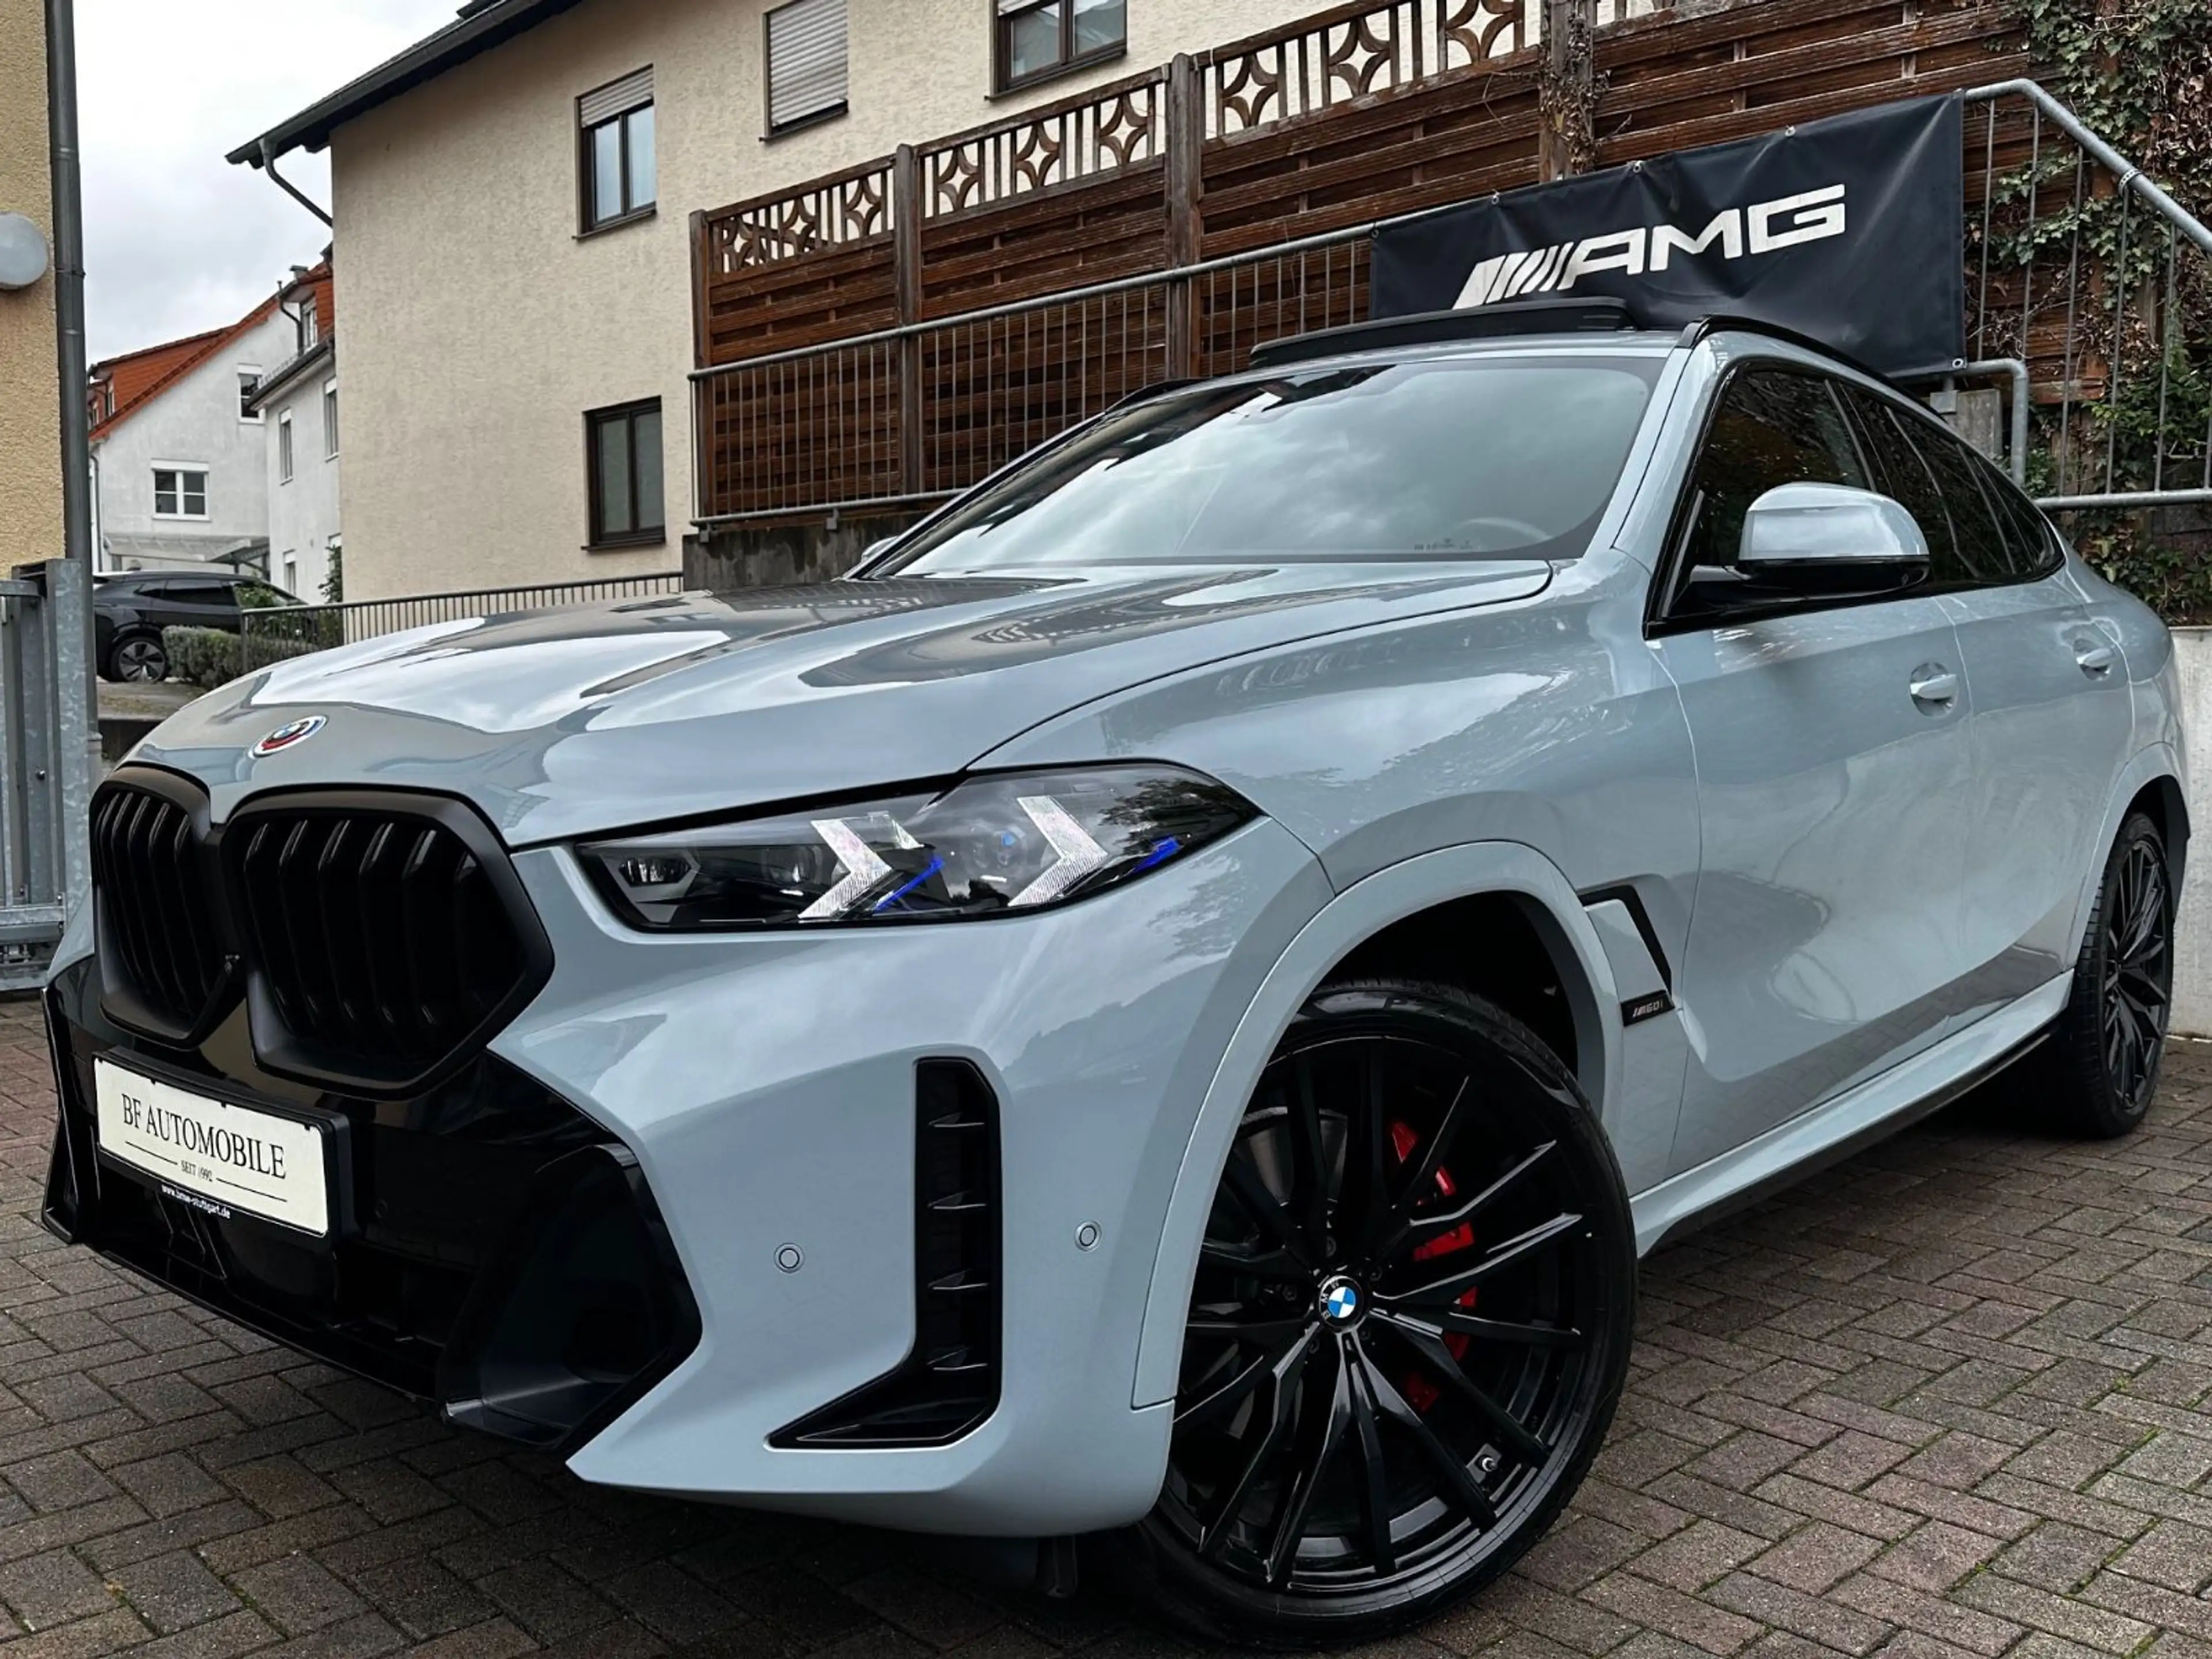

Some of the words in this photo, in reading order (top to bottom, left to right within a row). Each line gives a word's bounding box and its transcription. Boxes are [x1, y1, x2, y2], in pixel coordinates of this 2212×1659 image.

[1556, 183, 1845, 290] AMG
[121, 1093, 142, 1129] BF
[146, 1104, 286, 1180] AUTOMOBILE
[180, 1160, 197, 1176] SEIT
[198, 1166, 213, 1183] 1992
